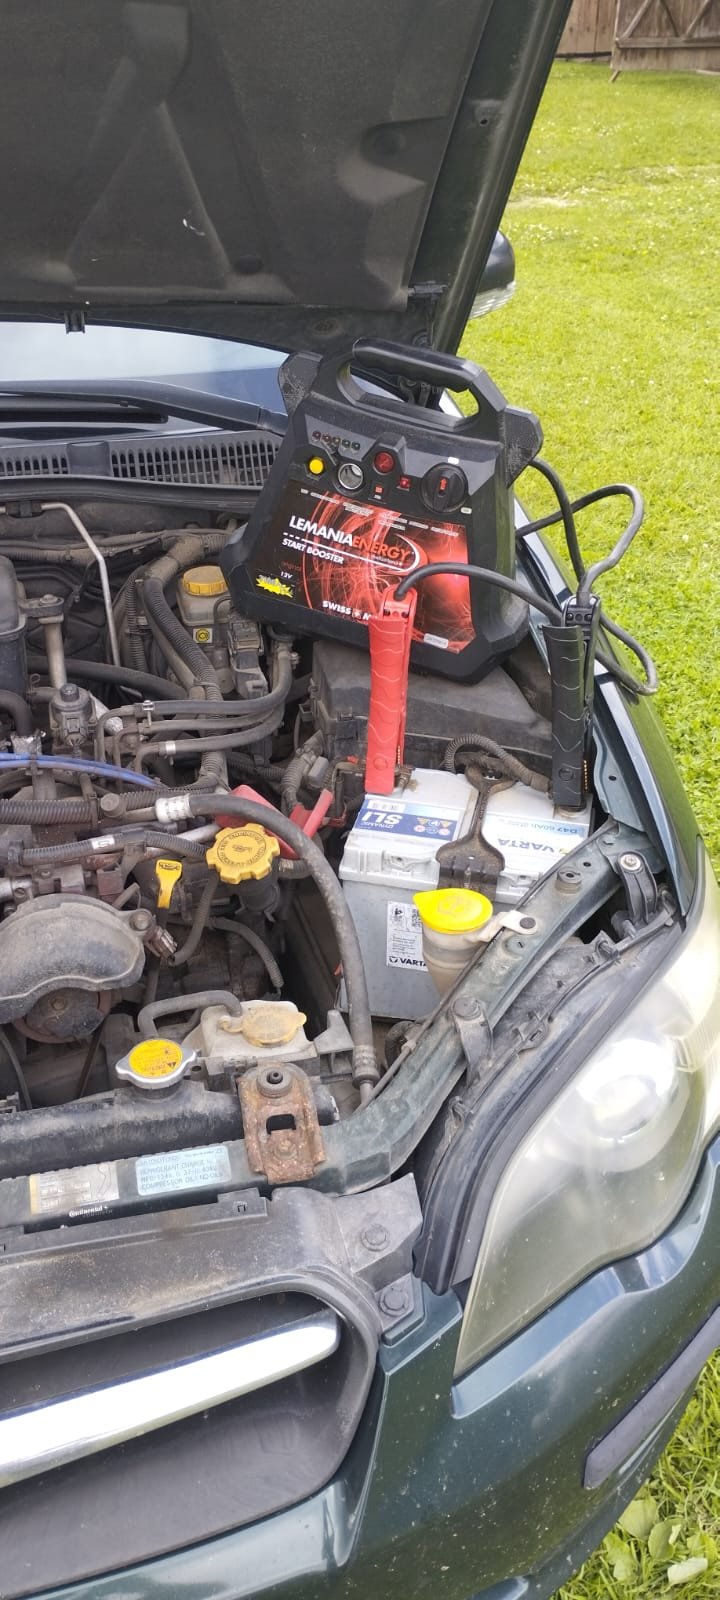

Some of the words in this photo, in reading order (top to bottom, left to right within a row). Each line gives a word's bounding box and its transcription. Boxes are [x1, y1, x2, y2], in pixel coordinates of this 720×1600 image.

[282, 538, 306, 552] START
[306, 545, 345, 564] BOOSTER
[280, 571, 293, 579] 12V
[322, 600, 352, 615] SWISS
[361, 811, 403, 826] SLI
[556, 826, 578, 834] D47
[497, 838, 555, 854] VARTA
[69, 1205, 103, 1218] Continental
